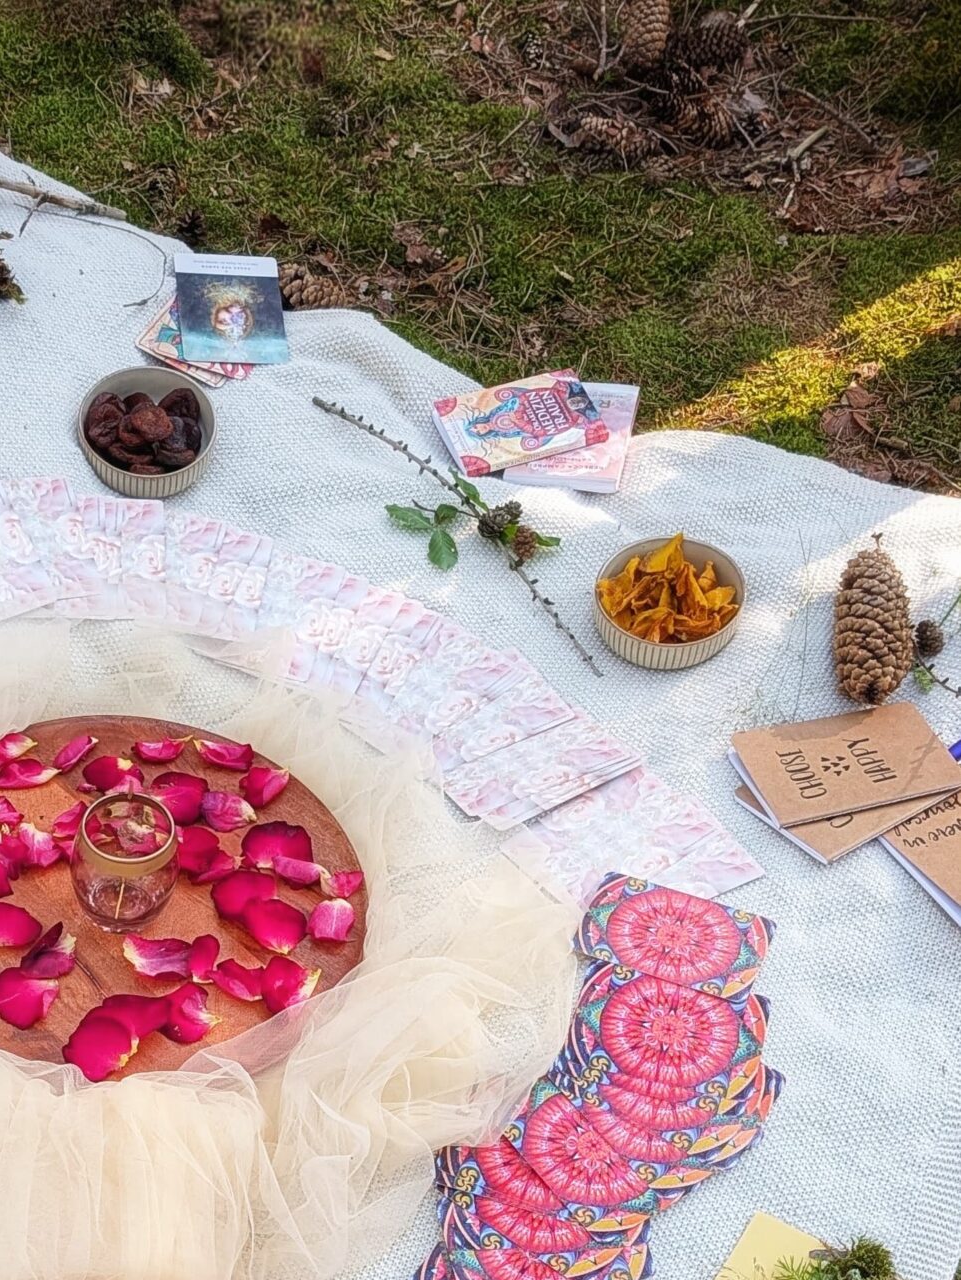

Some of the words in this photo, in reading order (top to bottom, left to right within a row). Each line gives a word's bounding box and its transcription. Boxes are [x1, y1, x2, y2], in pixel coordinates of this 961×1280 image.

[526, 391, 558, 435] MEDIZIN
[527, 407, 542, 431] ORAKEL
[540, 390, 569, 430] FRAUEN
[775, 748, 828, 800] CHOOSE
[841, 737, 897, 784] HAPPY
